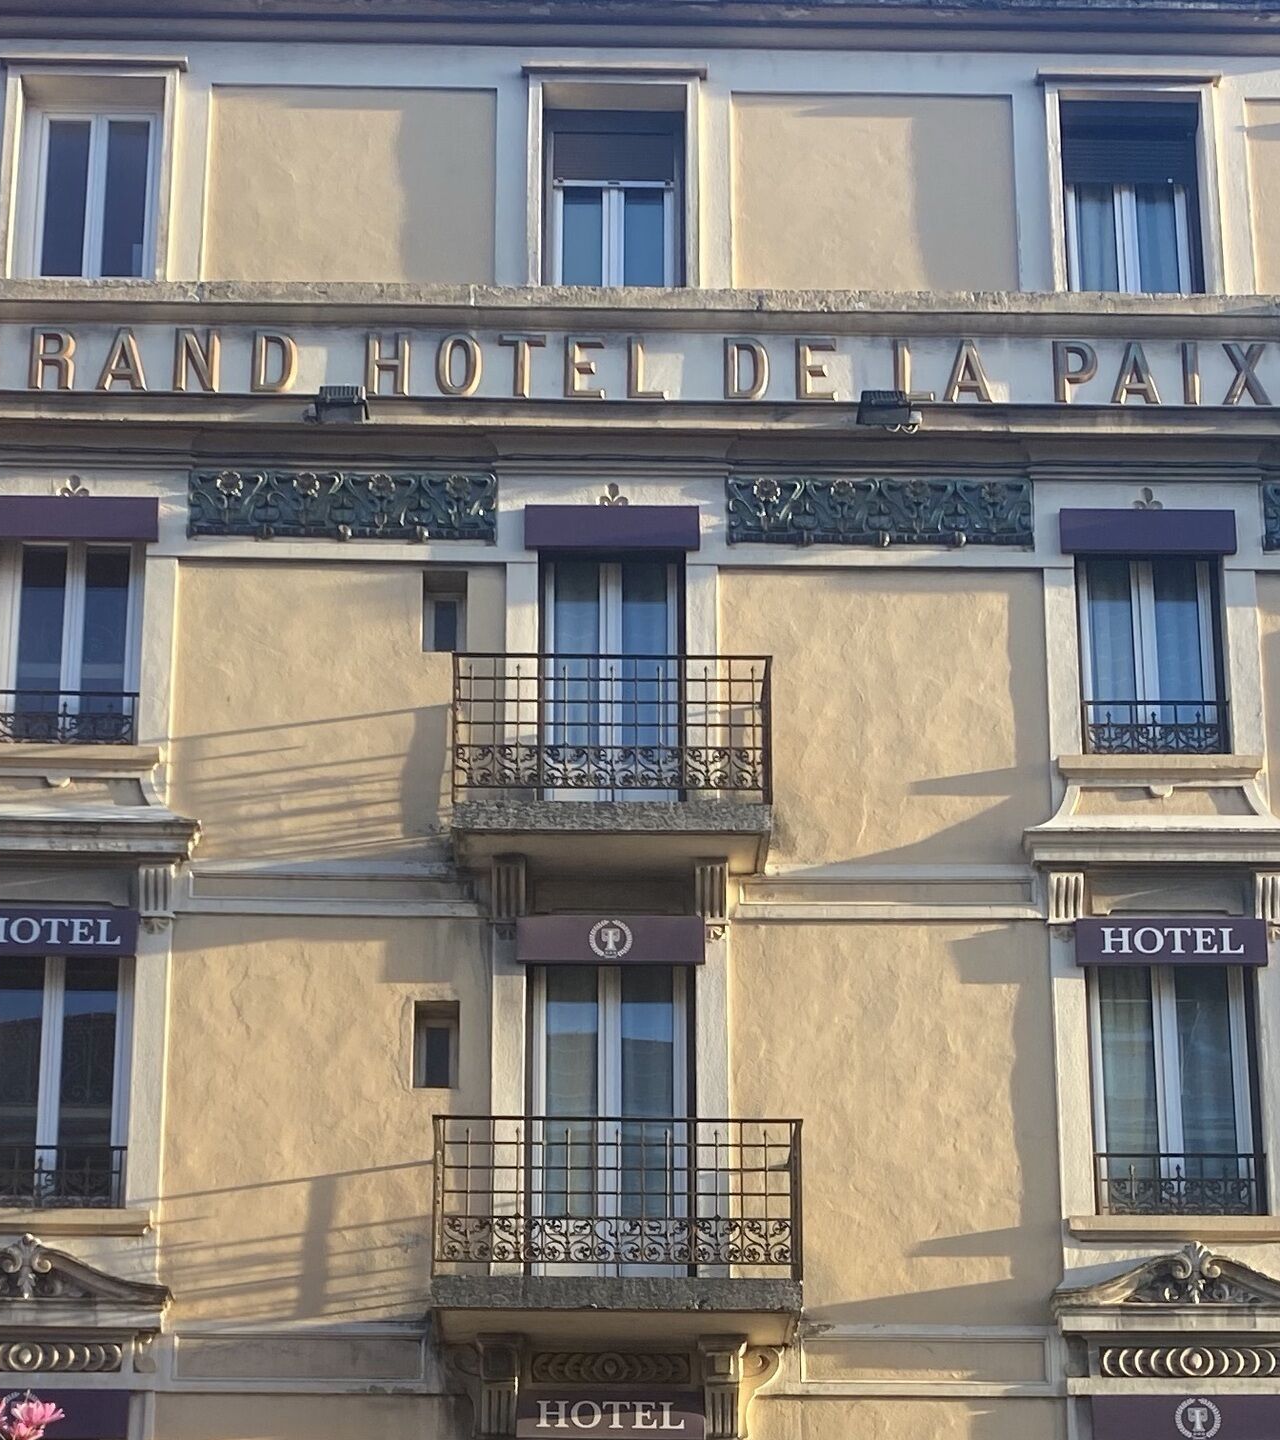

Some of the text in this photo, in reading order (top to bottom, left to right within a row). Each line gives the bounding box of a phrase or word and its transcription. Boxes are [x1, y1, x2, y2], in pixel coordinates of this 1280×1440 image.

[364, 328, 670, 401] HOTEL
[723, 336, 839, 402] DE
[892, 337, 995, 403] LA
[1051, 340, 1274, 407] PAIX
[1100, 926, 1245, 955] HOTEL
[535, 1400, 686, 1430] HOTEL
